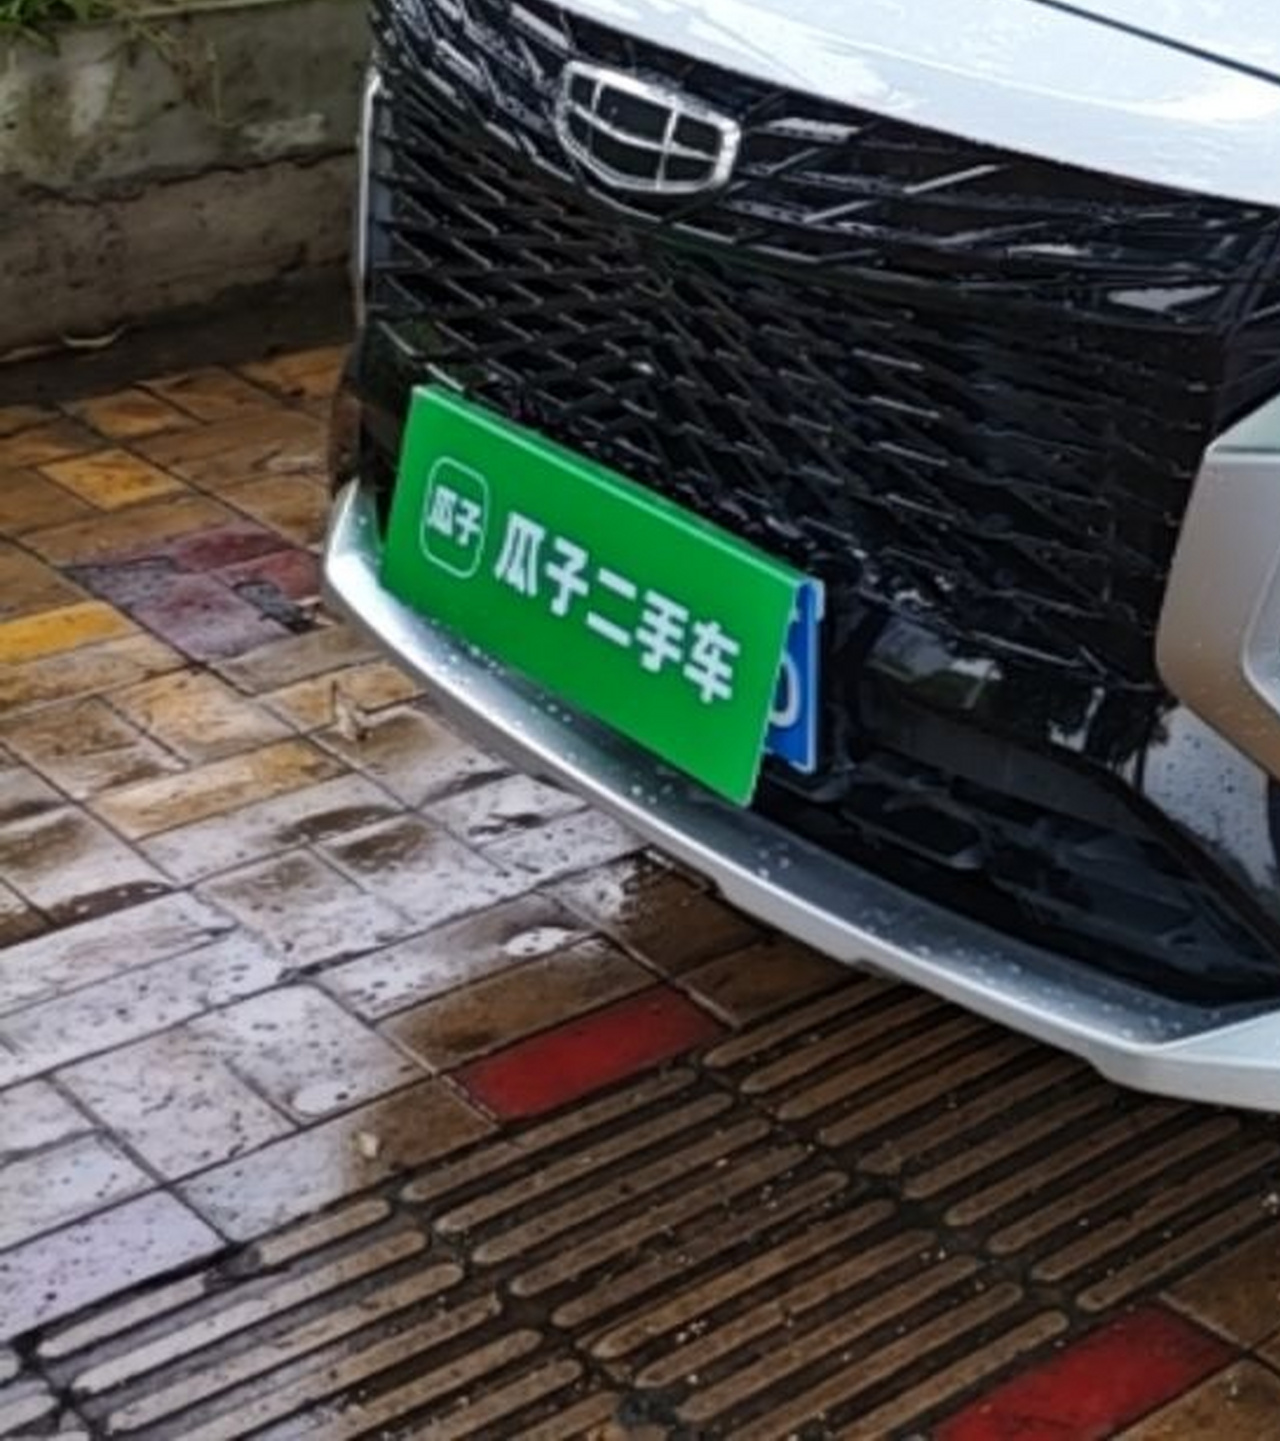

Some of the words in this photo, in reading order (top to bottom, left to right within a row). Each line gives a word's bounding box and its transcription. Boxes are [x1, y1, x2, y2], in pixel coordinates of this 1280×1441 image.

[427, 486, 481, 545] 瓜子
[494, 511, 740, 703] 瓜子二手车
